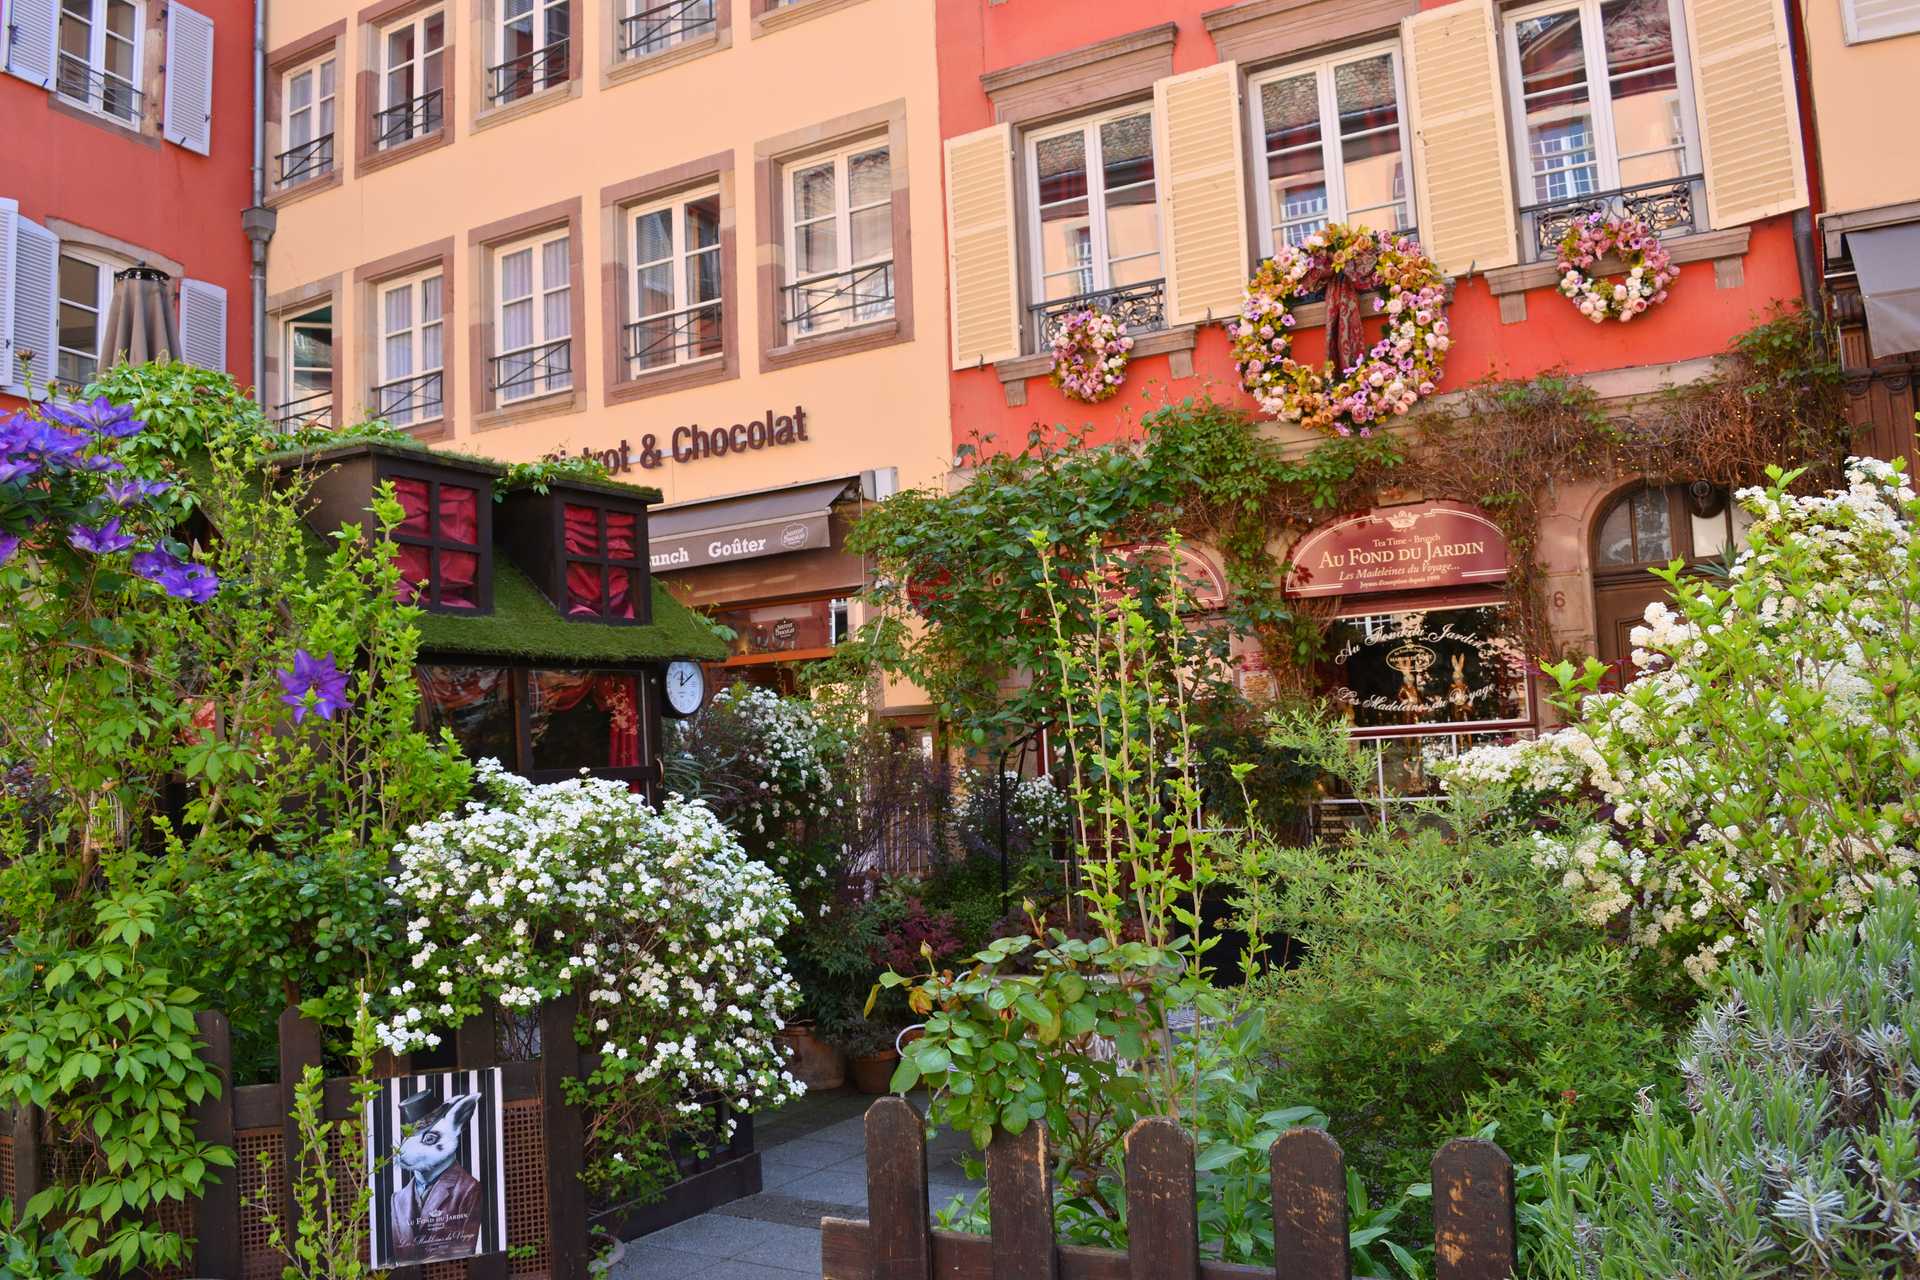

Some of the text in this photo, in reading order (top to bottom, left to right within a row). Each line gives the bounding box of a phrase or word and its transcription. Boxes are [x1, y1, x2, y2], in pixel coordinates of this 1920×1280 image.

[640, 433, 662, 469] &
[672, 405, 808, 463] Chocolat
[708, 537, 767, 557] Goûter
[1339, 571, 1354, 581] Les
[1356, 567, 1405, 580] Madeleines
[1554, 591, 1566, 608] 6
